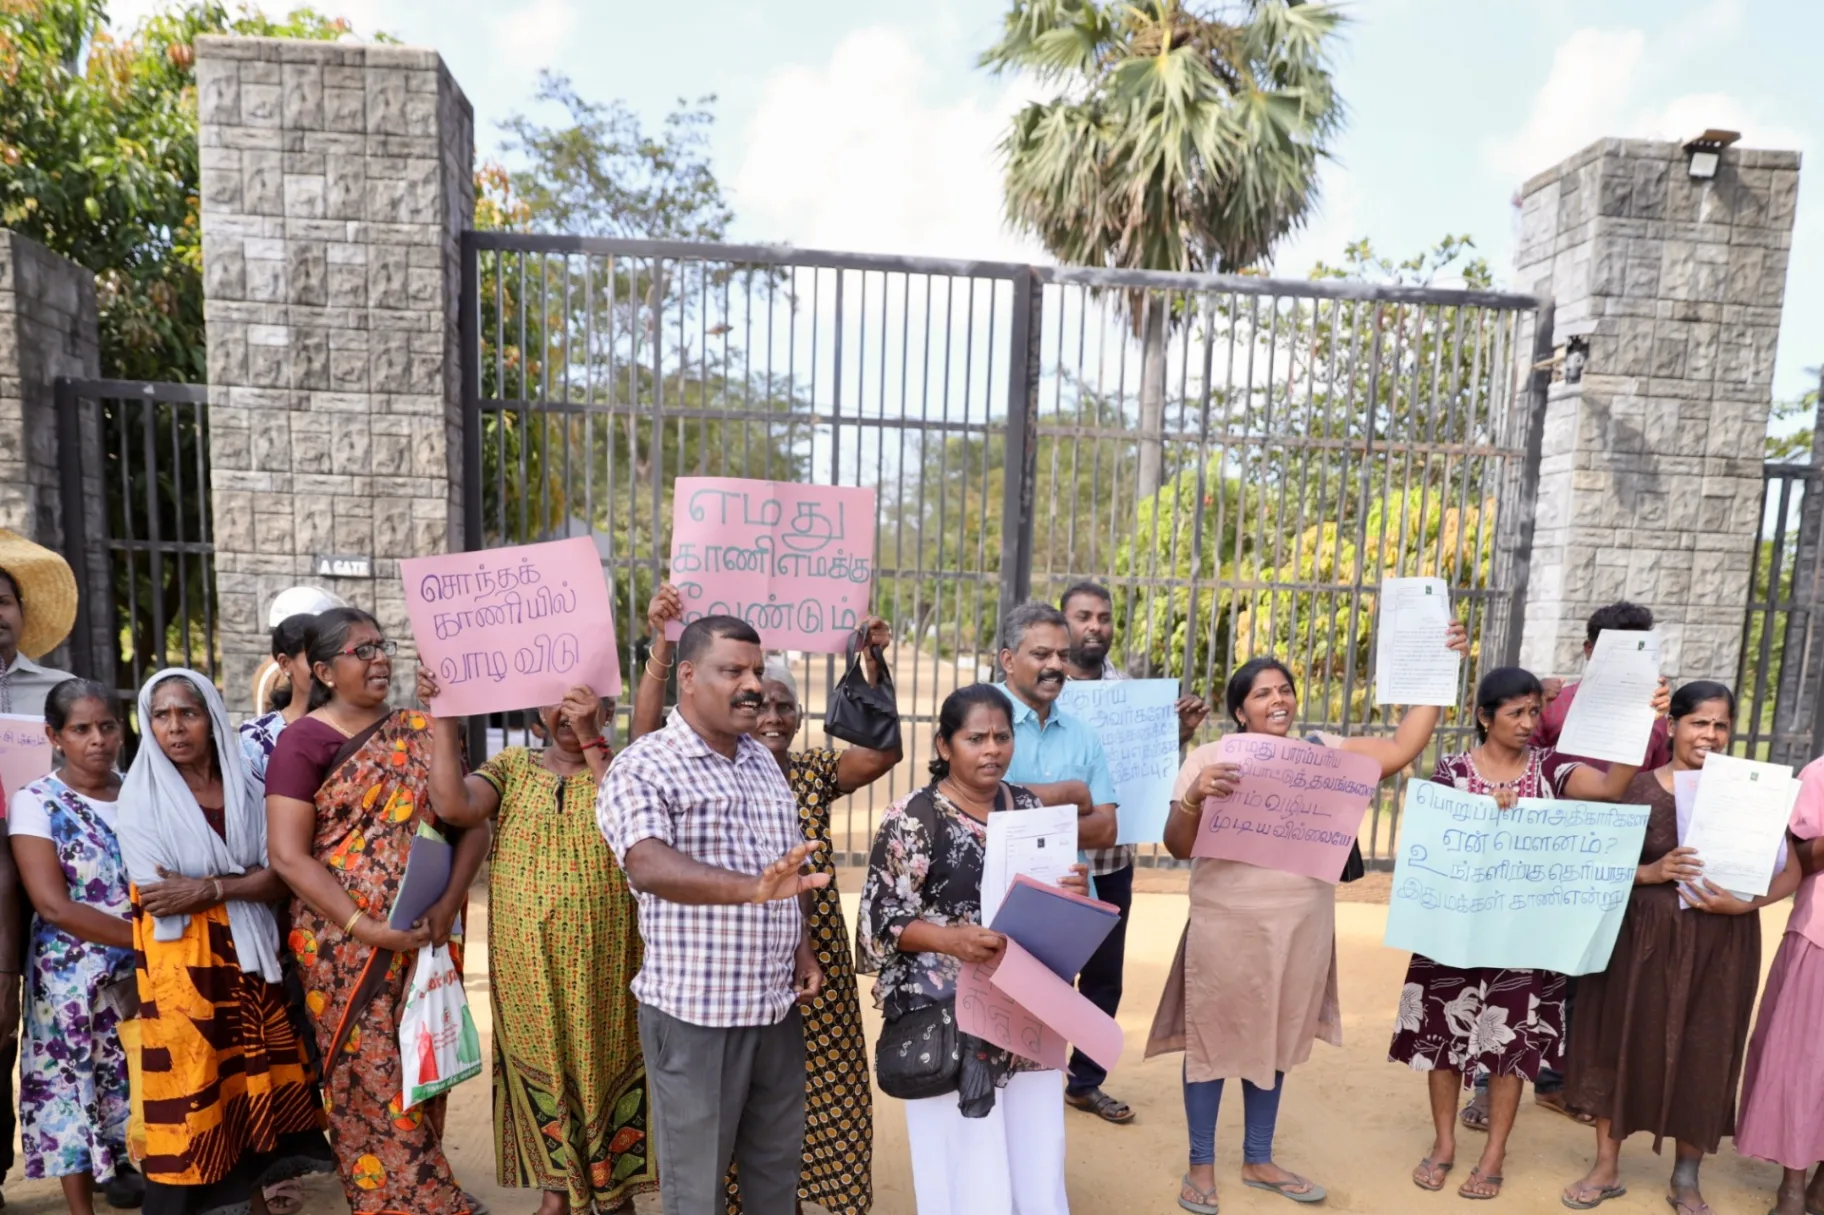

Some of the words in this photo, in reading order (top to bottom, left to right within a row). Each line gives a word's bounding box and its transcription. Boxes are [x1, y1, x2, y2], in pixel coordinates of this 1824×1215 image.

[689, 488, 844, 553] எமது
[420, 557, 541, 602] சொந்தக்
[433, 581, 577, 640] காணியில்
[1224, 738, 1276, 761] எமது
[1280, 742, 1342, 769] பாரம்பரிய
[1442, 828, 1490, 854] ஏன்
